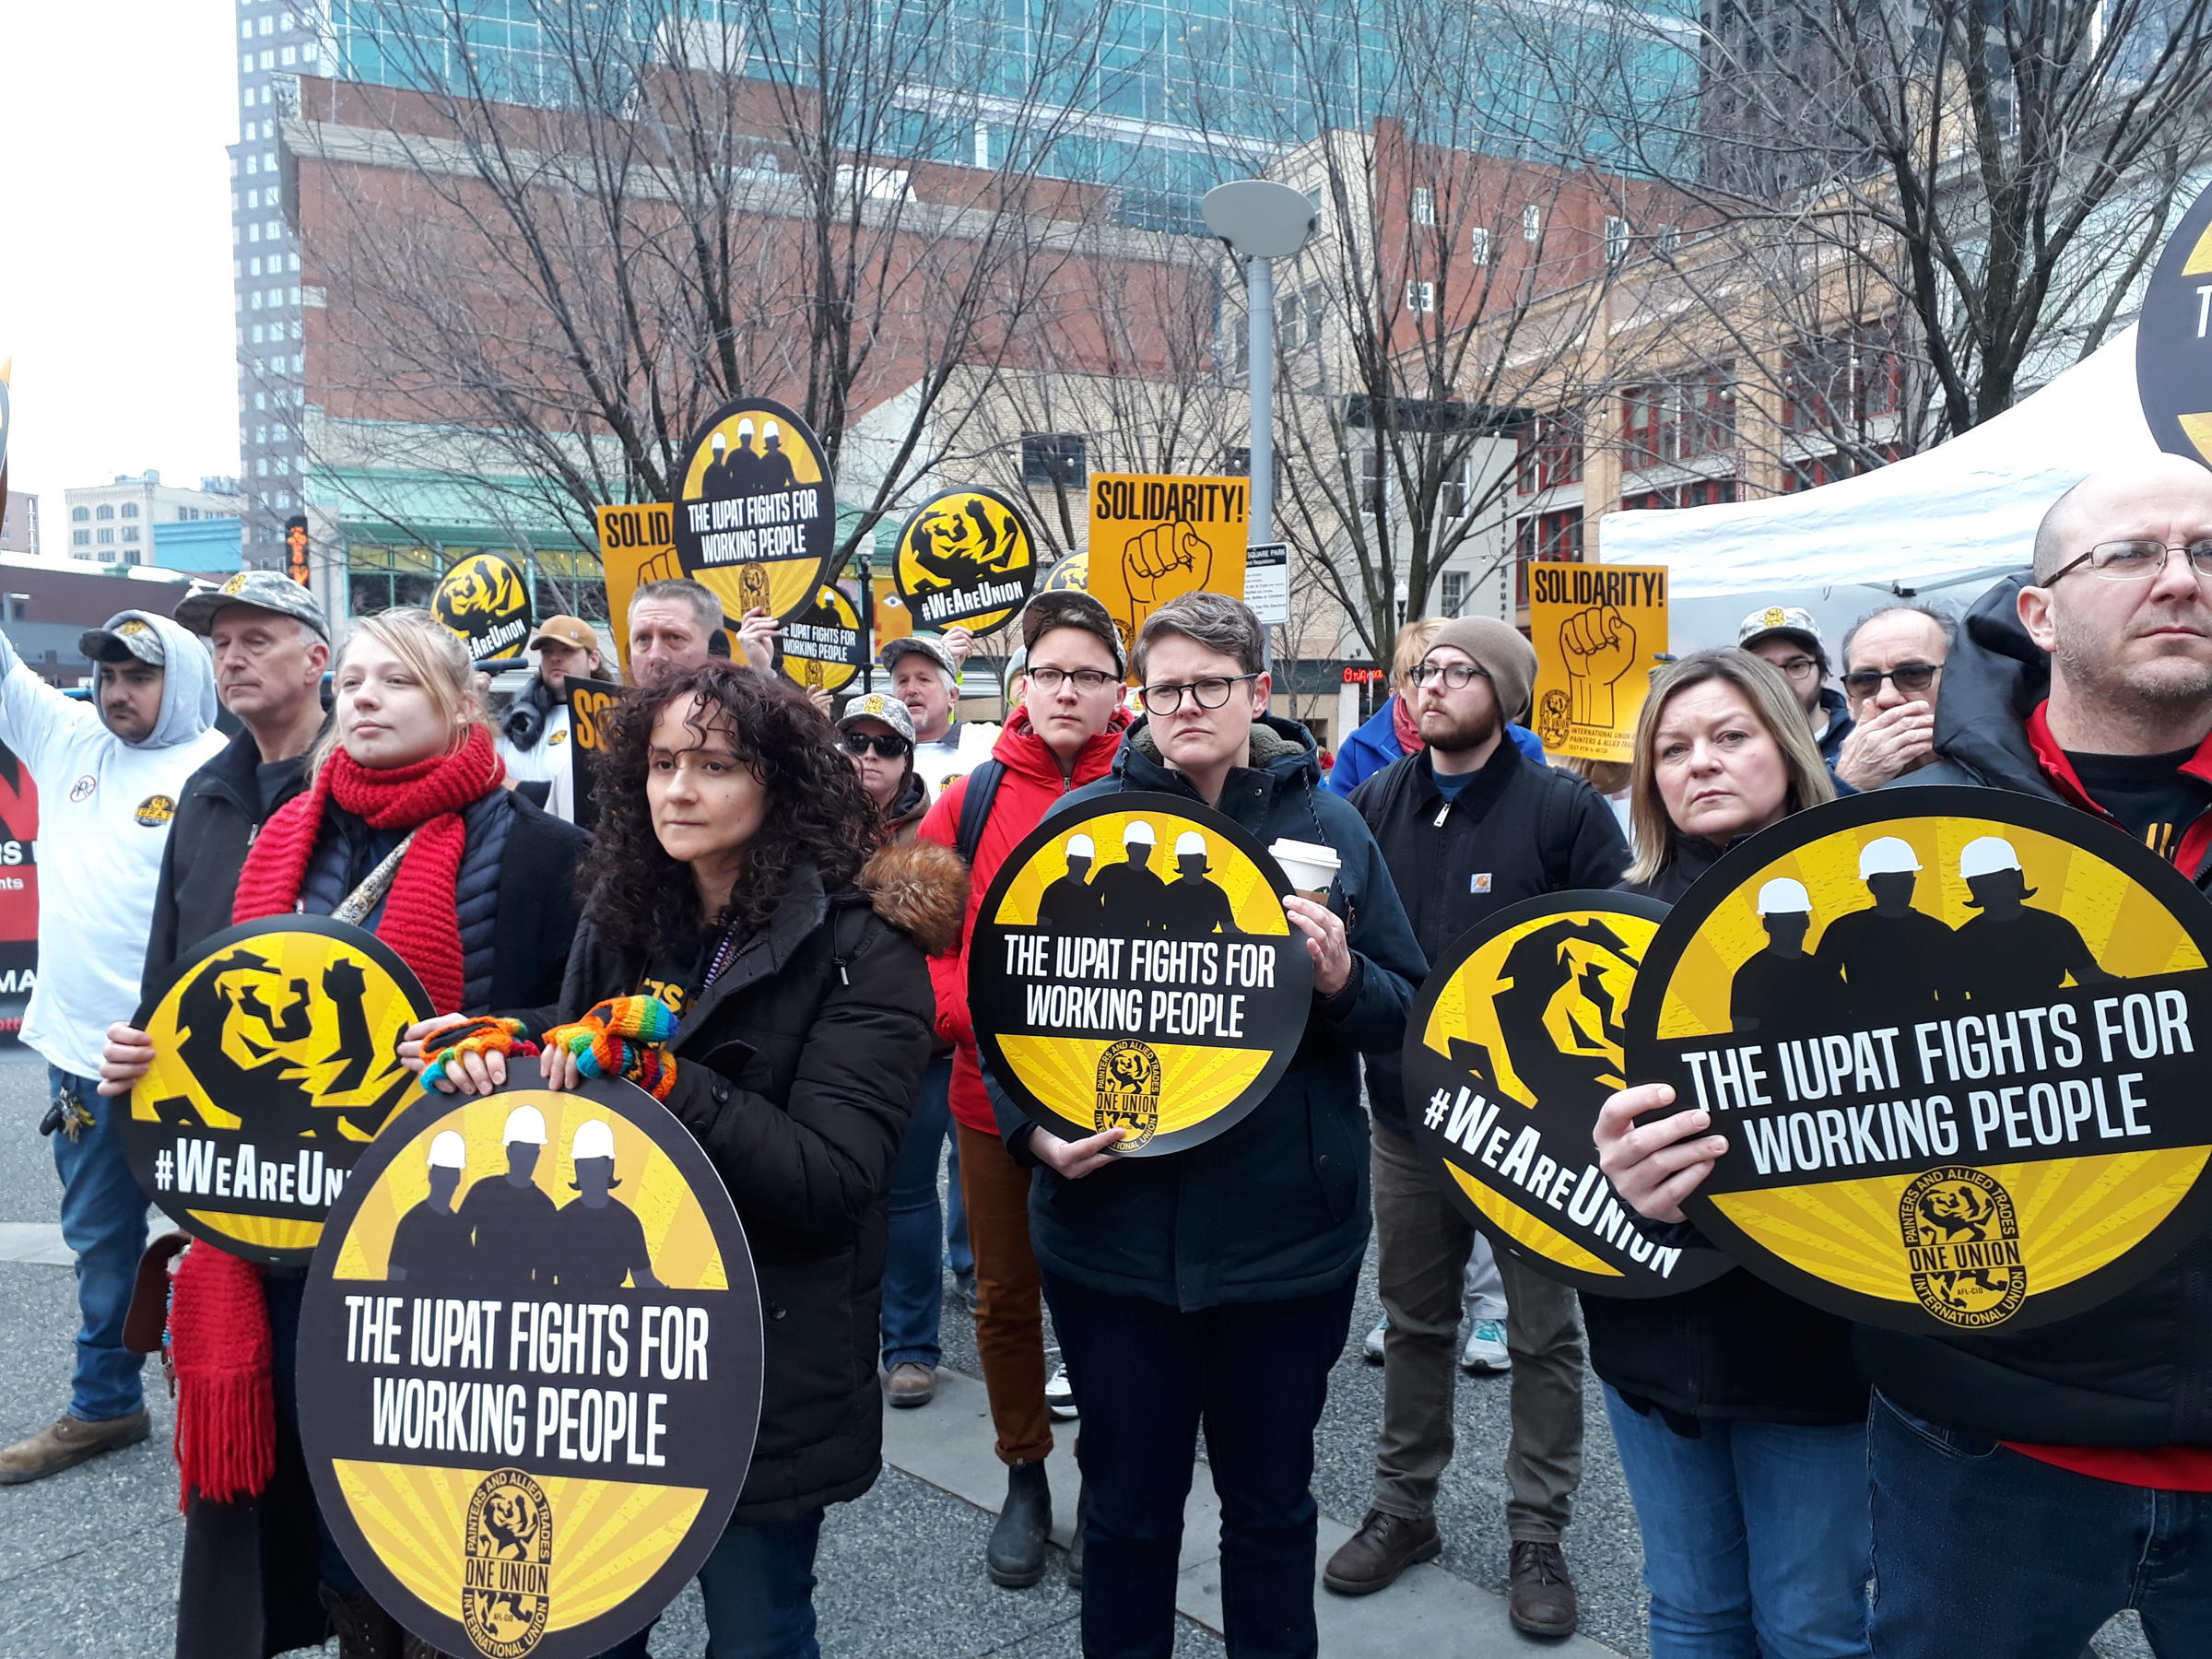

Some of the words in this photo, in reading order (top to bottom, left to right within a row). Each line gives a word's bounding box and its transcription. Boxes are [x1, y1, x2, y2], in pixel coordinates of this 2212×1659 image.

[688, 502, 711, 533] THE
[712, 499, 744, 530] IUPAT
[747, 492, 790, 525] FIGHTS
[792, 488, 818, 520] FOR
[1096, 480, 1243, 523] SOLIDARITY!
[605, 512, 674, 547] SOLID
[701, 529, 757, 563] WORKING
[759, 524, 806, 557] PEOPLE
[1270, 548, 1286, 557] PARK
[1535, 569, 1665, 607] SOLIDARITY!
[782, 638, 818, 657] WORKING
[818, 643, 847, 662] PEOPLE
[791, 622, 811, 640] IUPAT
[812, 626, 838, 644] FIGHTS
[840, 629, 856, 646] FOR
[1570, 736, 1596, 745] PAINTERS
[1571, 727, 1613, 738] INTERNATIONAL
[1004, 934, 1049, 977] THE
[1055, 935, 1124, 980] IUPAT
[1130, 939, 1218, 986] FIGHTS
[1225, 943, 1276, 988] FOR
[1026, 983, 1143, 1032] WORKING
[1149, 990, 1245, 1038] PEOPLE
[1098, 1051, 1113, 1088] PAINTERS
[1112, 1041, 1128, 1054] AND
[1129, 1041, 1154, 1060] ALLIED
[1150, 1059, 1159, 1093] TRADES
[1681, 1045, 1771, 1112] THE
[1778, 1026, 1900, 1102] IUPAT
[1913, 1002, 2083, 1087] FIGHTS
[2092, 988, 2194, 1064] FOR
[1097, 1092, 1118, 1110] ONE
[1122, 1094, 1159, 1113] UNION
[1140, 1117, 1157, 1143] UNION
[1743, 1096, 1959, 1175] WORKING
[1968, 1072, 2151, 1152] PEOPLE
[1901, 1187, 1920, 1243] PAINTERS
[1916, 1171, 1944, 1191] AND
[1947, 1169, 1994, 1189] ALLIED
[1992, 1187, 2016, 1235] TRADES
[1908, 1245, 1949, 1272] ONE
[1953, 1241, 2021, 1268] UNION
[1913, 1277, 2006, 1325] INTERNATIONAL
[2002, 1270, 2025, 1310] UNION
[1957, 1288, 1983, 1296] AFL-CIO
[345, 1295, 404, 1365] THE
[410, 1298, 501, 1370] IUPAT
[509, 1300, 629, 1378] FIGHTS
[640, 1305, 710, 1381] FOR
[372, 1376, 526, 1457] WORKING
[535, 1385, 668, 1467] PEOPLE
[467, 1487, 487, 1552] PAINTERS
[485, 1472, 507, 1493] AND
[509, 1472, 543, 1503] ALLIED
[537, 1502, 551, 1559] TRADES
[465, 1558, 494, 1588] ONE
[500, 1563, 549, 1594] UNION
[464, 1594, 525, 1657] INTERNATIONAL
[524, 1602, 547, 1644] UNION
